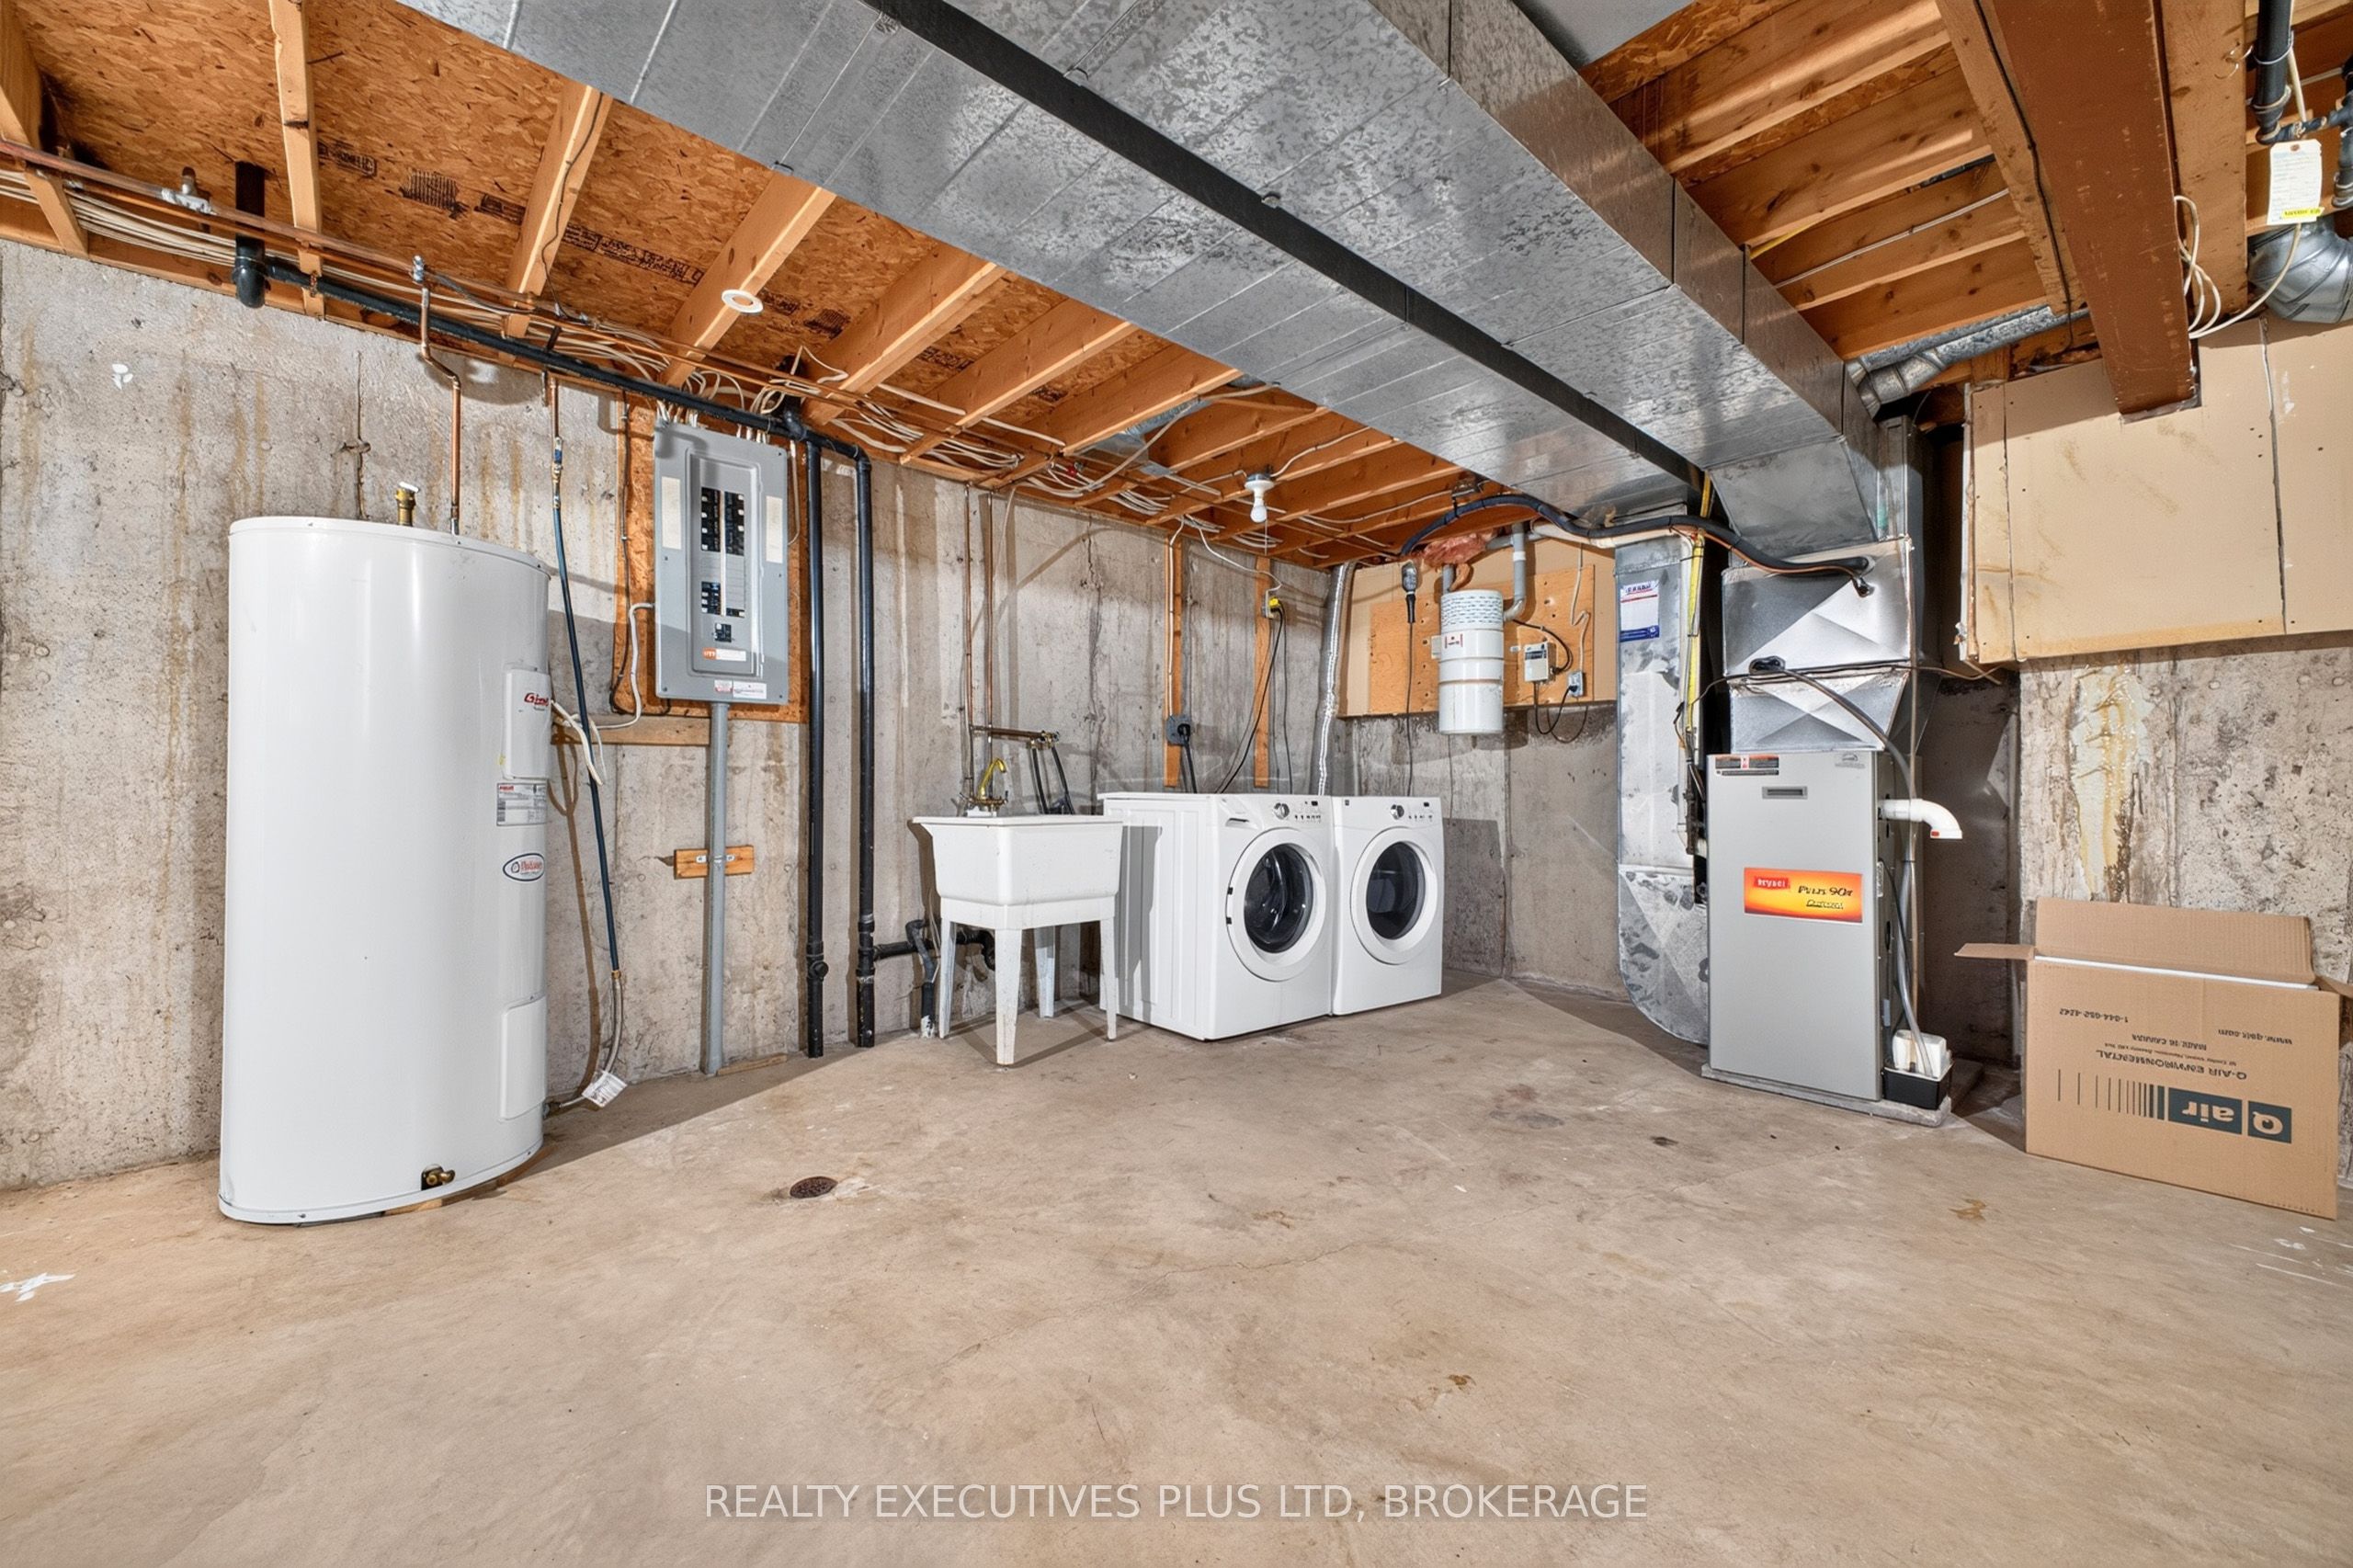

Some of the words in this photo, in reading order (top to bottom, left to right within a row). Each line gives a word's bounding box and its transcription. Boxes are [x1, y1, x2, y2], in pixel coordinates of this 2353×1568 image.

[2096, 1050, 2205, 1074] ENVIRONMENTAL
[2209, 1068, 2247, 1080] Q-AIR
[2181, 1101, 2235, 1122] air
[2253, 1111, 2283, 1135] Q
